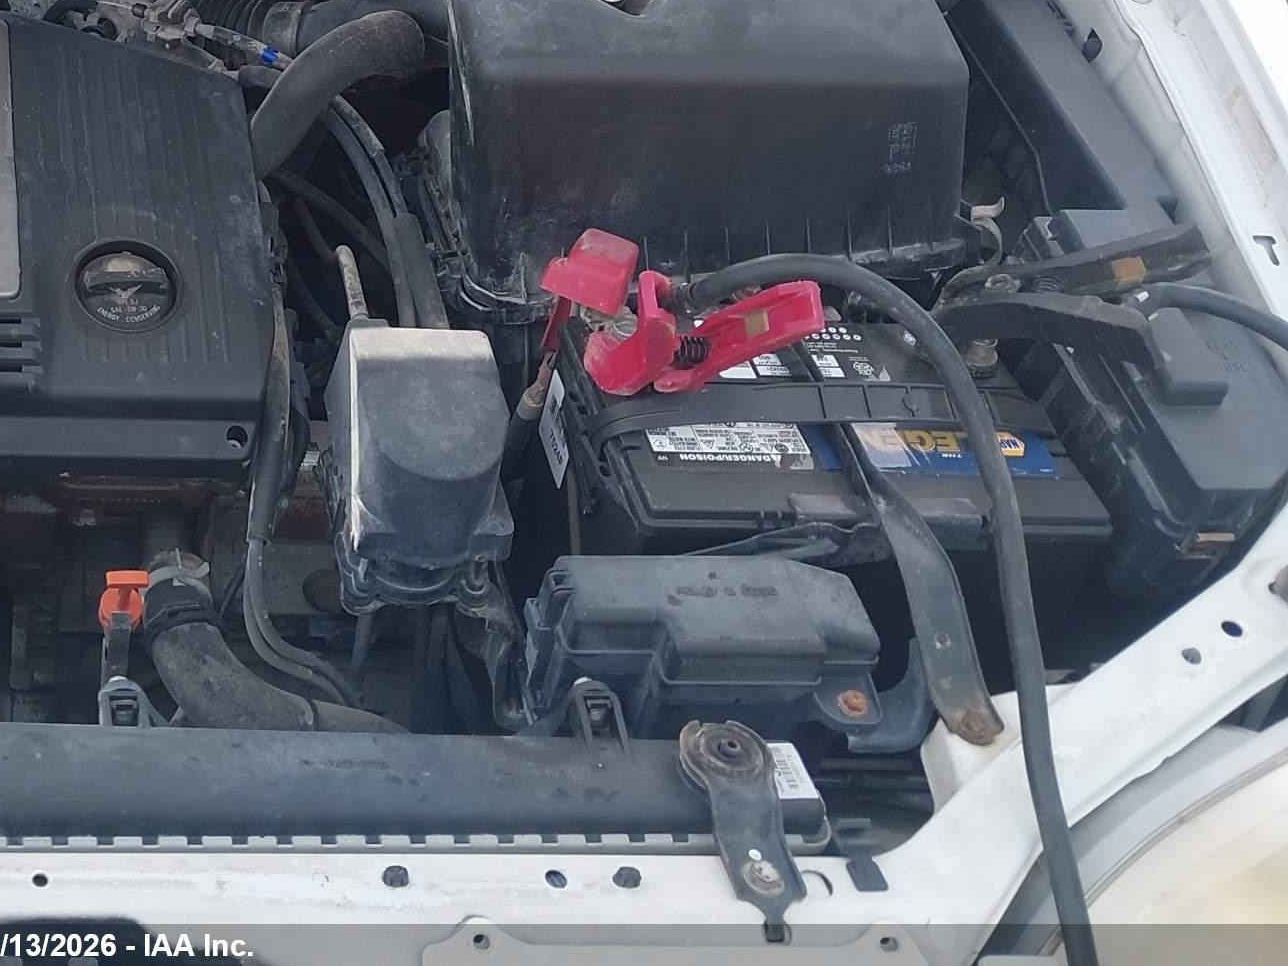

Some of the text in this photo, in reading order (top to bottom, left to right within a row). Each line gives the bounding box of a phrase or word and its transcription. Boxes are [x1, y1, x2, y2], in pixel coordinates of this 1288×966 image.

[96, 306, 121, 321] ENERGY
[999, 437, 1021, 450] NAP
[679, 453, 772, 462] DANGER/POISON
